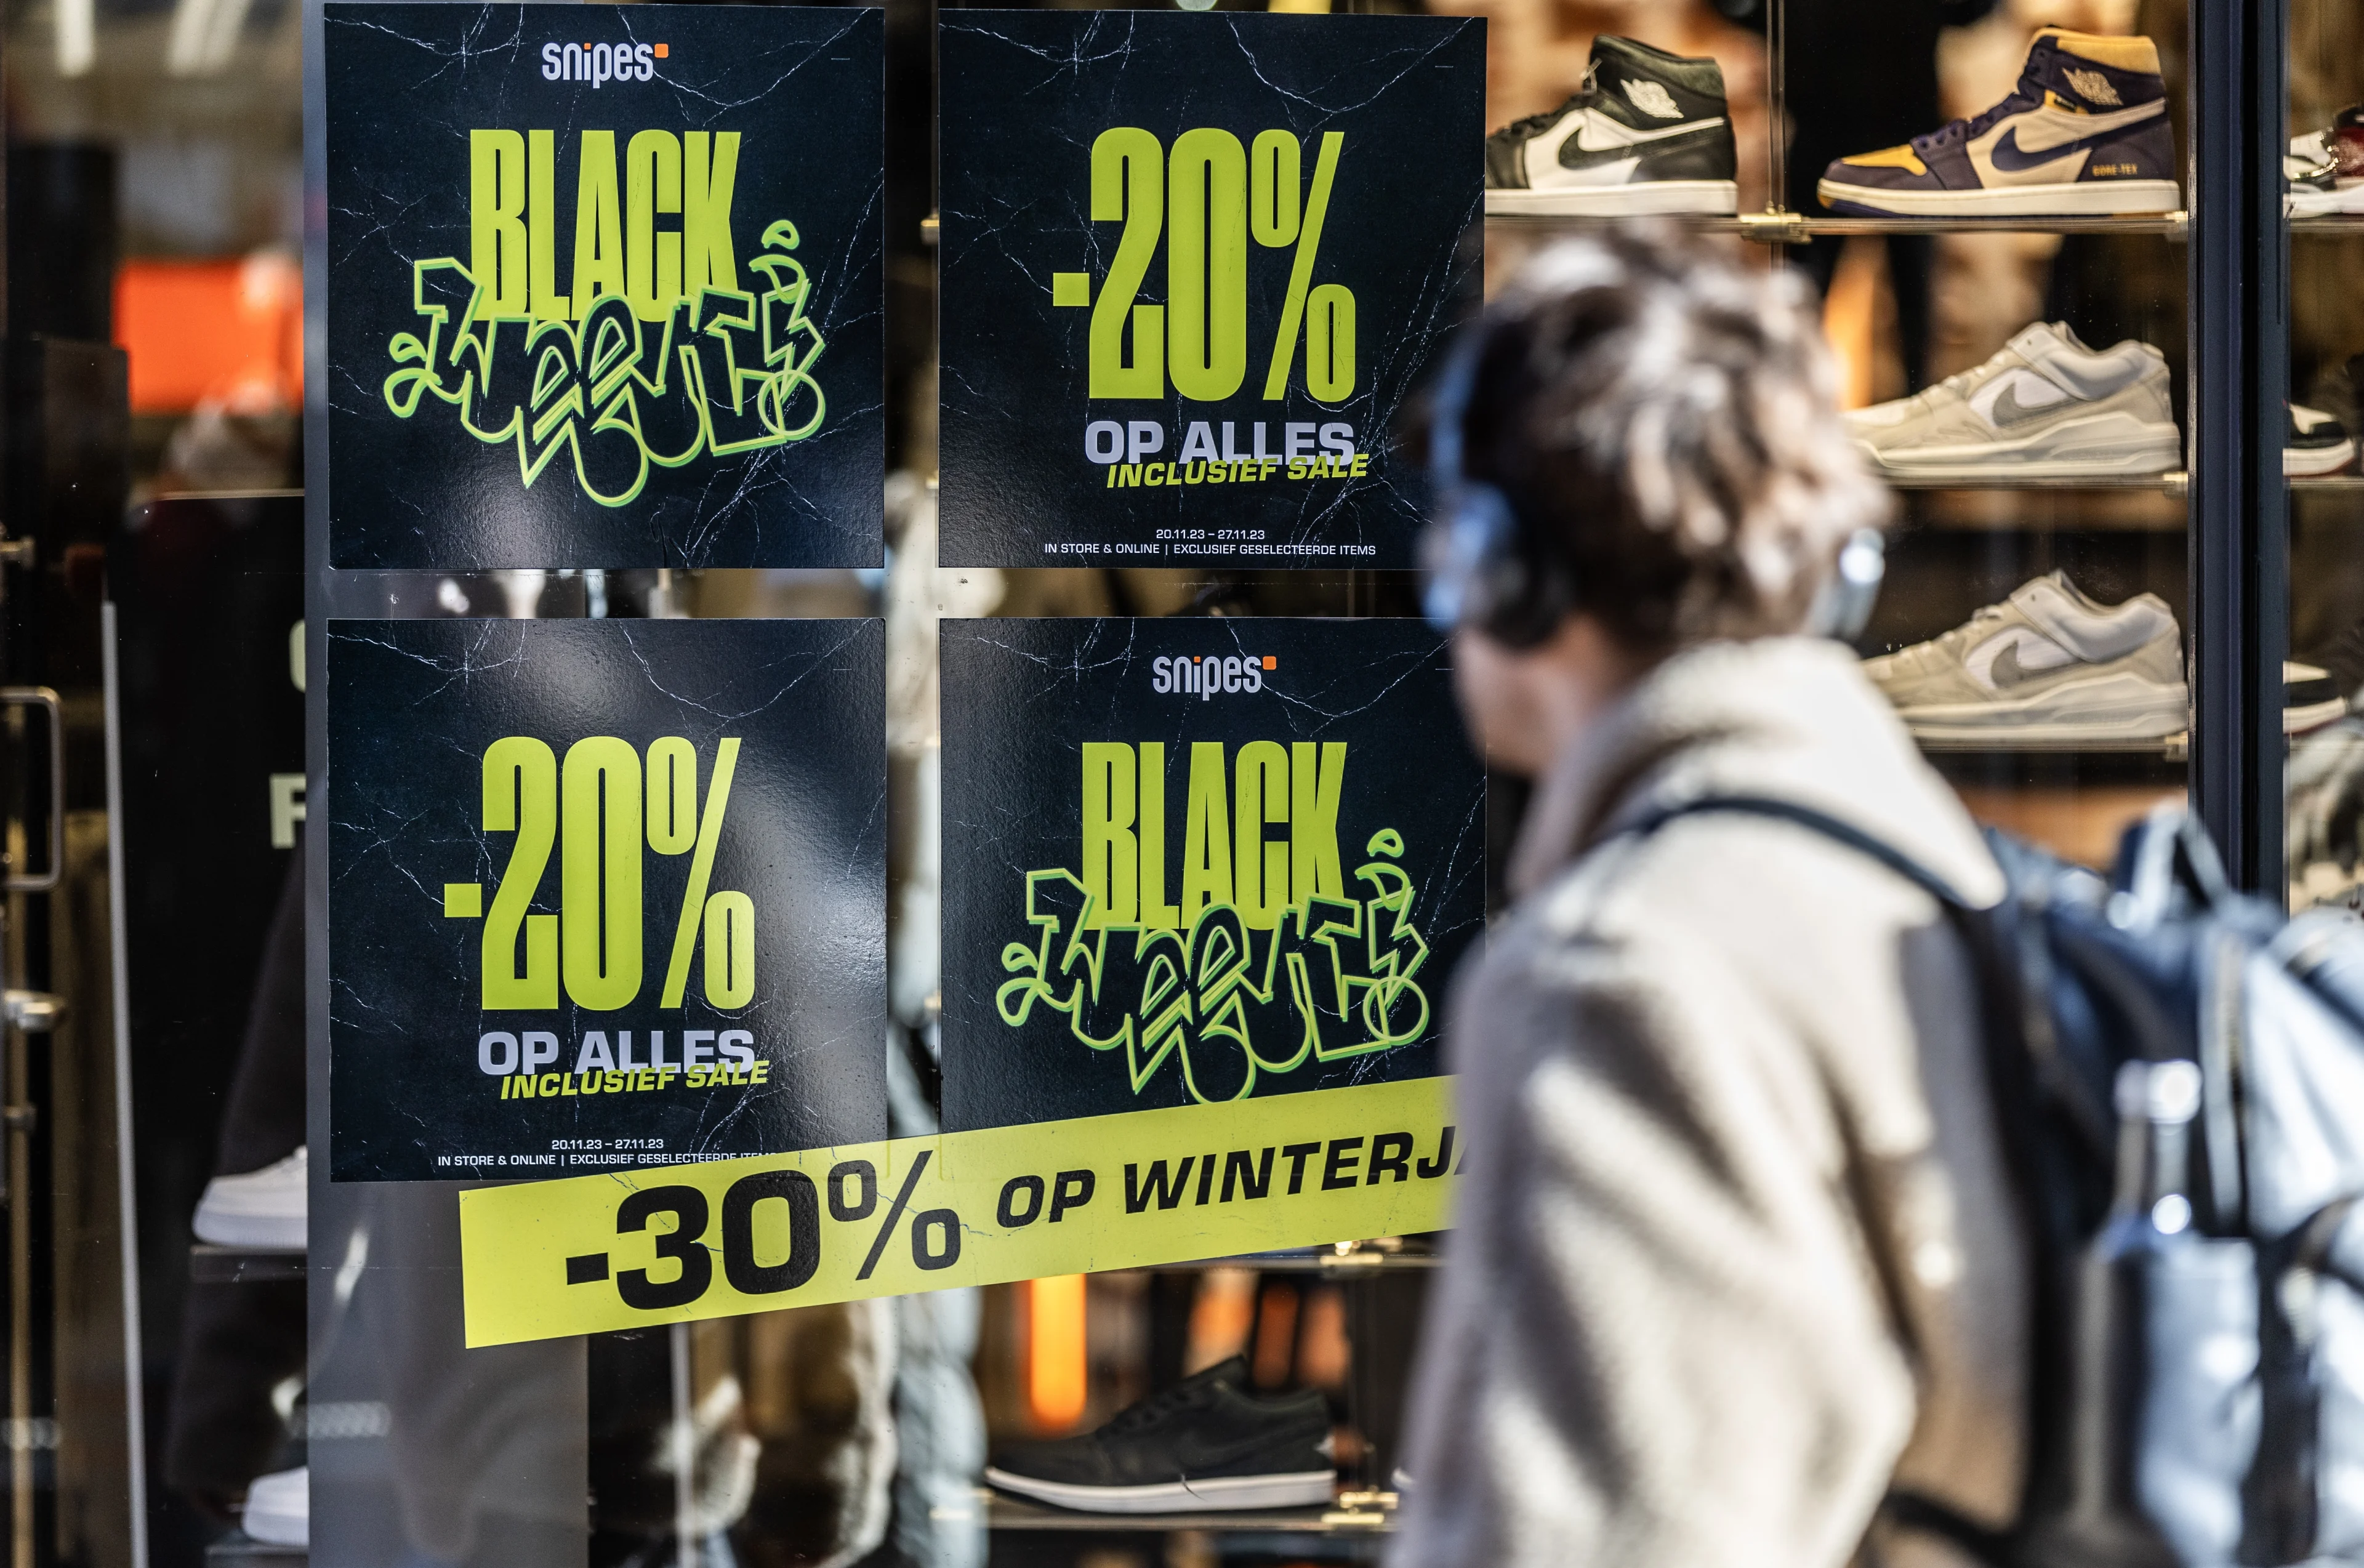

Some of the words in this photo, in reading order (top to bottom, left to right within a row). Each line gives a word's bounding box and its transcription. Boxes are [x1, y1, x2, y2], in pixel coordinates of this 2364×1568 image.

[541, 43, 654, 88] snipes
[470, 129, 741, 322] BLACK
[1053, 127, 1356, 403] -20%
[1085, 421, 1164, 464] OP
[1178, 422, 1354, 466] ALLES
[1107, 455, 1277, 488] INCLUSIEF
[1287, 453, 1369, 480] SALE
[1045, 544, 1057, 553] IN
[1061, 544, 1100, 553] STORE
[1104, 544, 1112, 553] &
[1116, 544, 1160, 553] ONLINE
[1174, 544, 1236, 554] EXCLUSIEF
[1239, 545, 1336, 554] GESELECTEERDE
[1340, 545, 1376, 555] ITEMS
[1156, 529, 1205, 539] 20.11.23
[1218, 530, 1265, 539] 27.11.23
[1152, 656, 1262, 701] snipes
[1082, 741, 1348, 930] BLACK
[444, 736, 755, 1011] -20%
[478, 1031, 558, 1075] OP
[574, 1029, 755, 1074] ALLES
[501, 1067, 676, 1100] INCLUSIEF
[685, 1060, 770, 1088] SALE
[438, 1156, 451, 1166] IN
[454, 1156, 494, 1165] STORE
[498, 1156, 507, 1165] &
[510, 1155, 556, 1165] ONLINE
[569, 1154, 635, 1165] EXCLUSIEF
[552, 1140, 602, 1150] 20.11.23
[615, 1138, 664, 1149] 27.11.23
[566, 1149, 961, 1310] -30%
[996, 1168, 1095, 1229] OP
